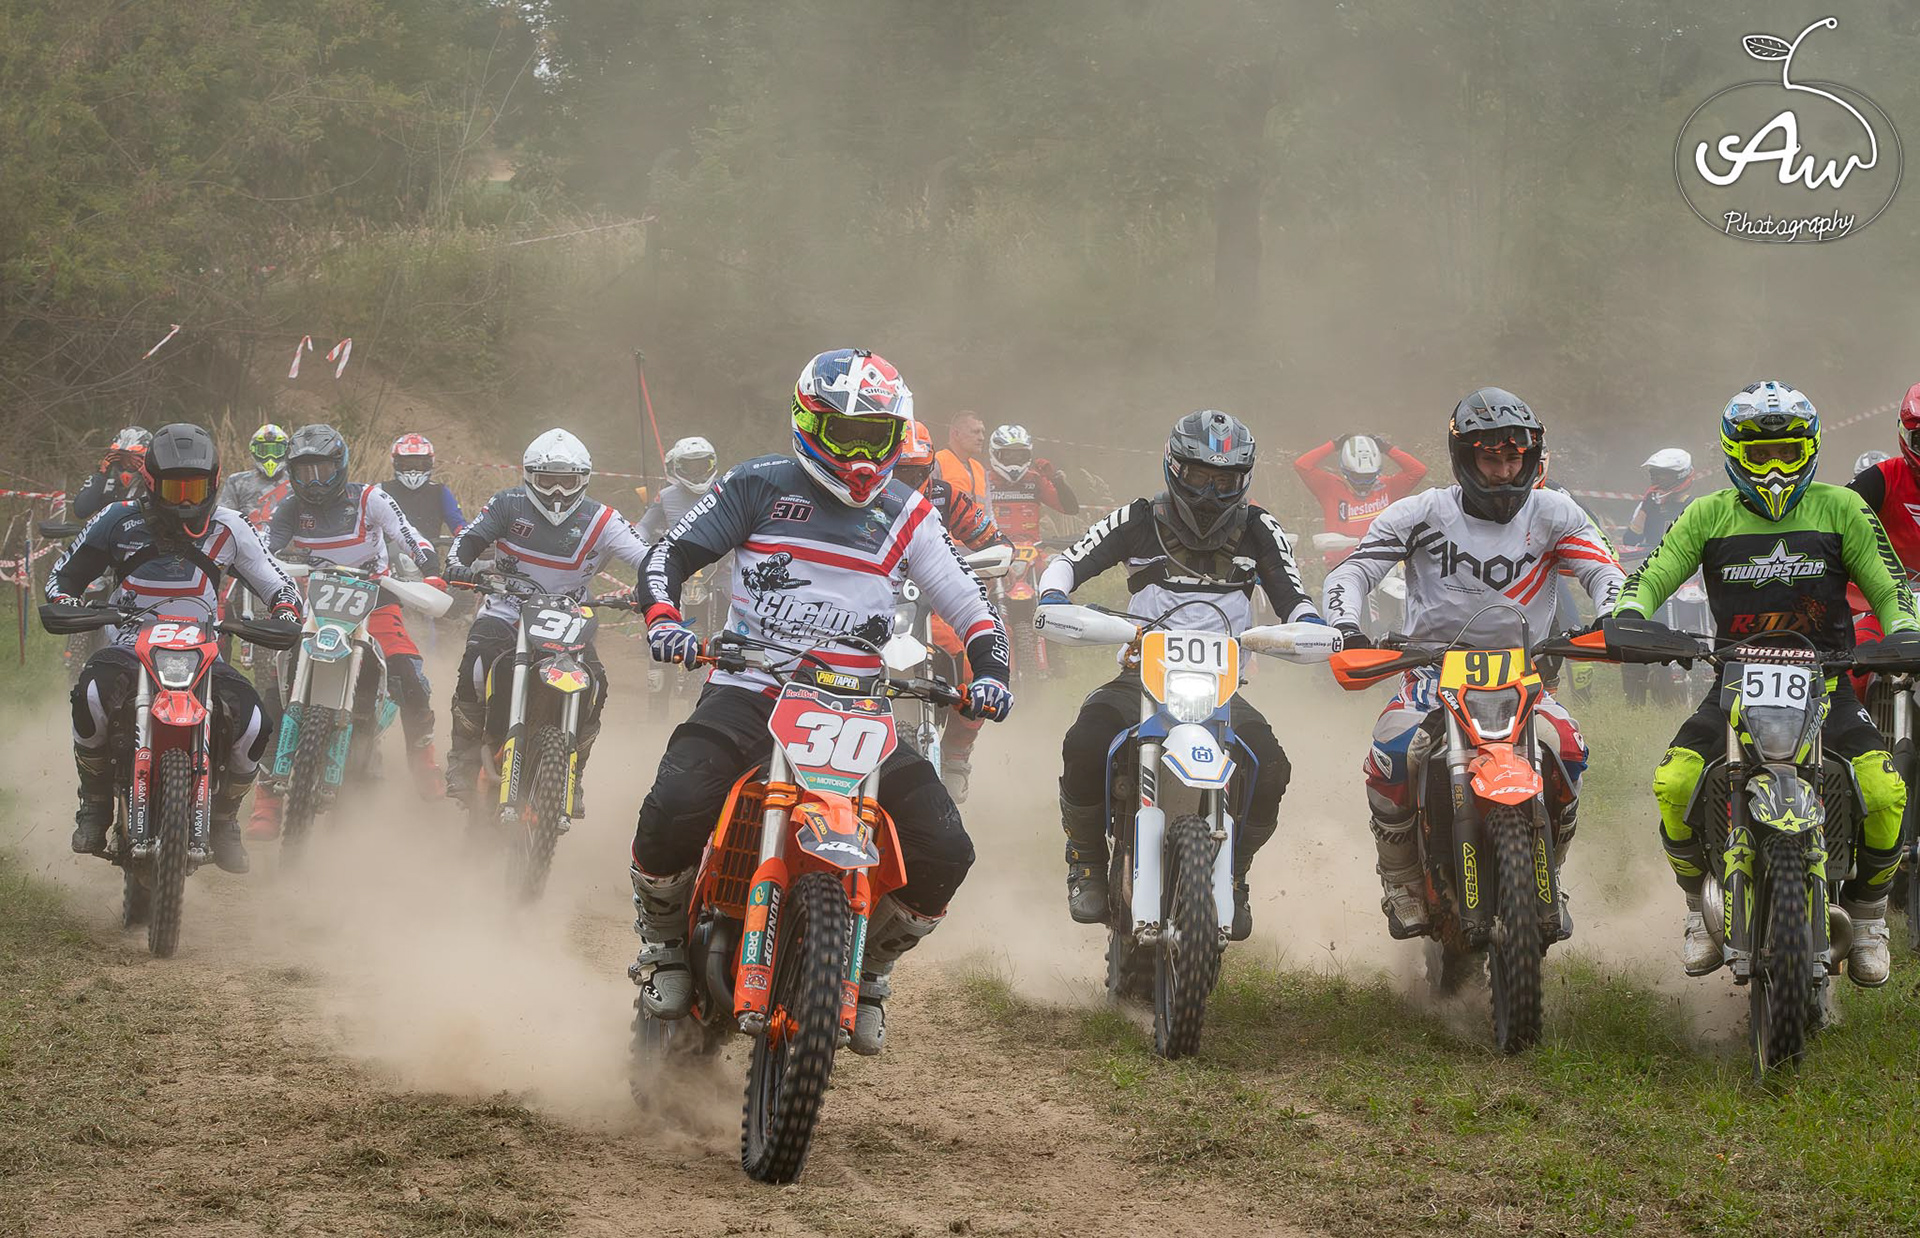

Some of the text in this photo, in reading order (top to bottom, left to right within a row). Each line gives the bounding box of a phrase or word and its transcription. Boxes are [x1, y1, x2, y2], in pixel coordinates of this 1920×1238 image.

[669, 493, 717, 542] Chelm
[772, 502, 813, 522] 30
[1722, 561, 1826, 581] THUMPSTAR
[314, 584, 370, 616] 273
[755, 591, 858, 632] Chelm
[148, 623, 201, 645] 64
[529, 609, 588, 644] 31
[1167, 637, 1224, 668] 501
[1465, 651, 1512, 687] 97
[1441, 690, 1460, 711] KTM
[1745, 670, 1808, 701] 518
[786, 711, 889, 775] 30
[510, 750, 522, 801] DUNLOP
[816, 776, 852, 788] MOTOREX
[137, 804, 146, 834] Team
[194, 809, 204, 837] M&M
[766, 887, 781, 967] DUNLOP
[856, 917, 868, 969] MOTOREX
